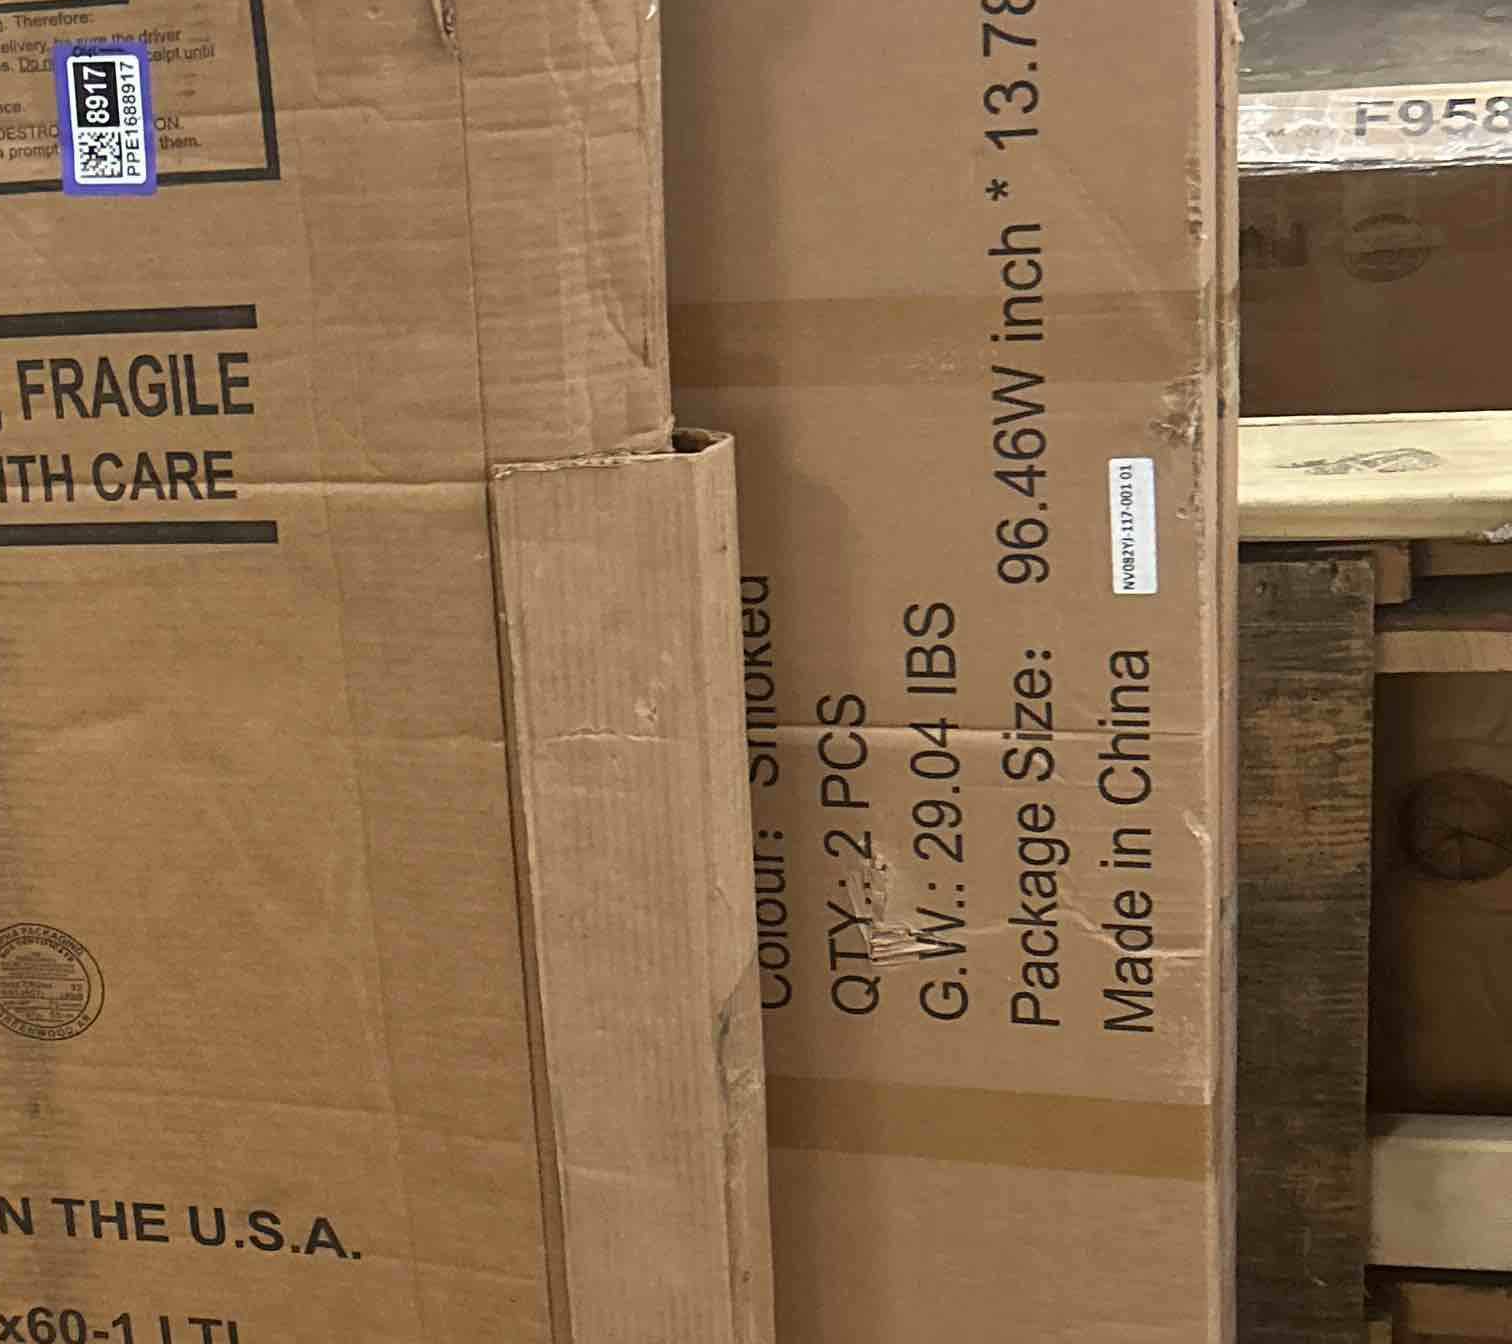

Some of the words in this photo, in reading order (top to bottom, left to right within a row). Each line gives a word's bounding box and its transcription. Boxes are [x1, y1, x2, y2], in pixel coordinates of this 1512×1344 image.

[13, 10, 95, 29] Therefore:
[137, 28, 182, 45] driver
[183, 44, 216, 59] until
[81, 65, 111, 125] 8917
[119, 60, 141, 177] PPE1688917
[8, 143, 60, 162] prompt
[158, 134, 202, 151] them.
[988, 220, 1044, 345] inch
[15, 352, 256, 422] FRAGILE
[91, 450, 239, 502] CARE
[991, 364, 1052, 586] 96.46W
[1001, 645, 1055, 783] Size:
[1097, 648, 1153, 808] China
[815, 692, 871, 810] PCS
[909, 715, 965, 865] 29.04
[822, 829, 873, 858] 2
[1098, 841, 1153, 869] in
[1009, 801, 1070, 1028] Package
[1101, 891, 1155, 1035] Made
[51, 1196, 170, 1244] THE
[188, 1204, 362, 1260] U.S.A.
